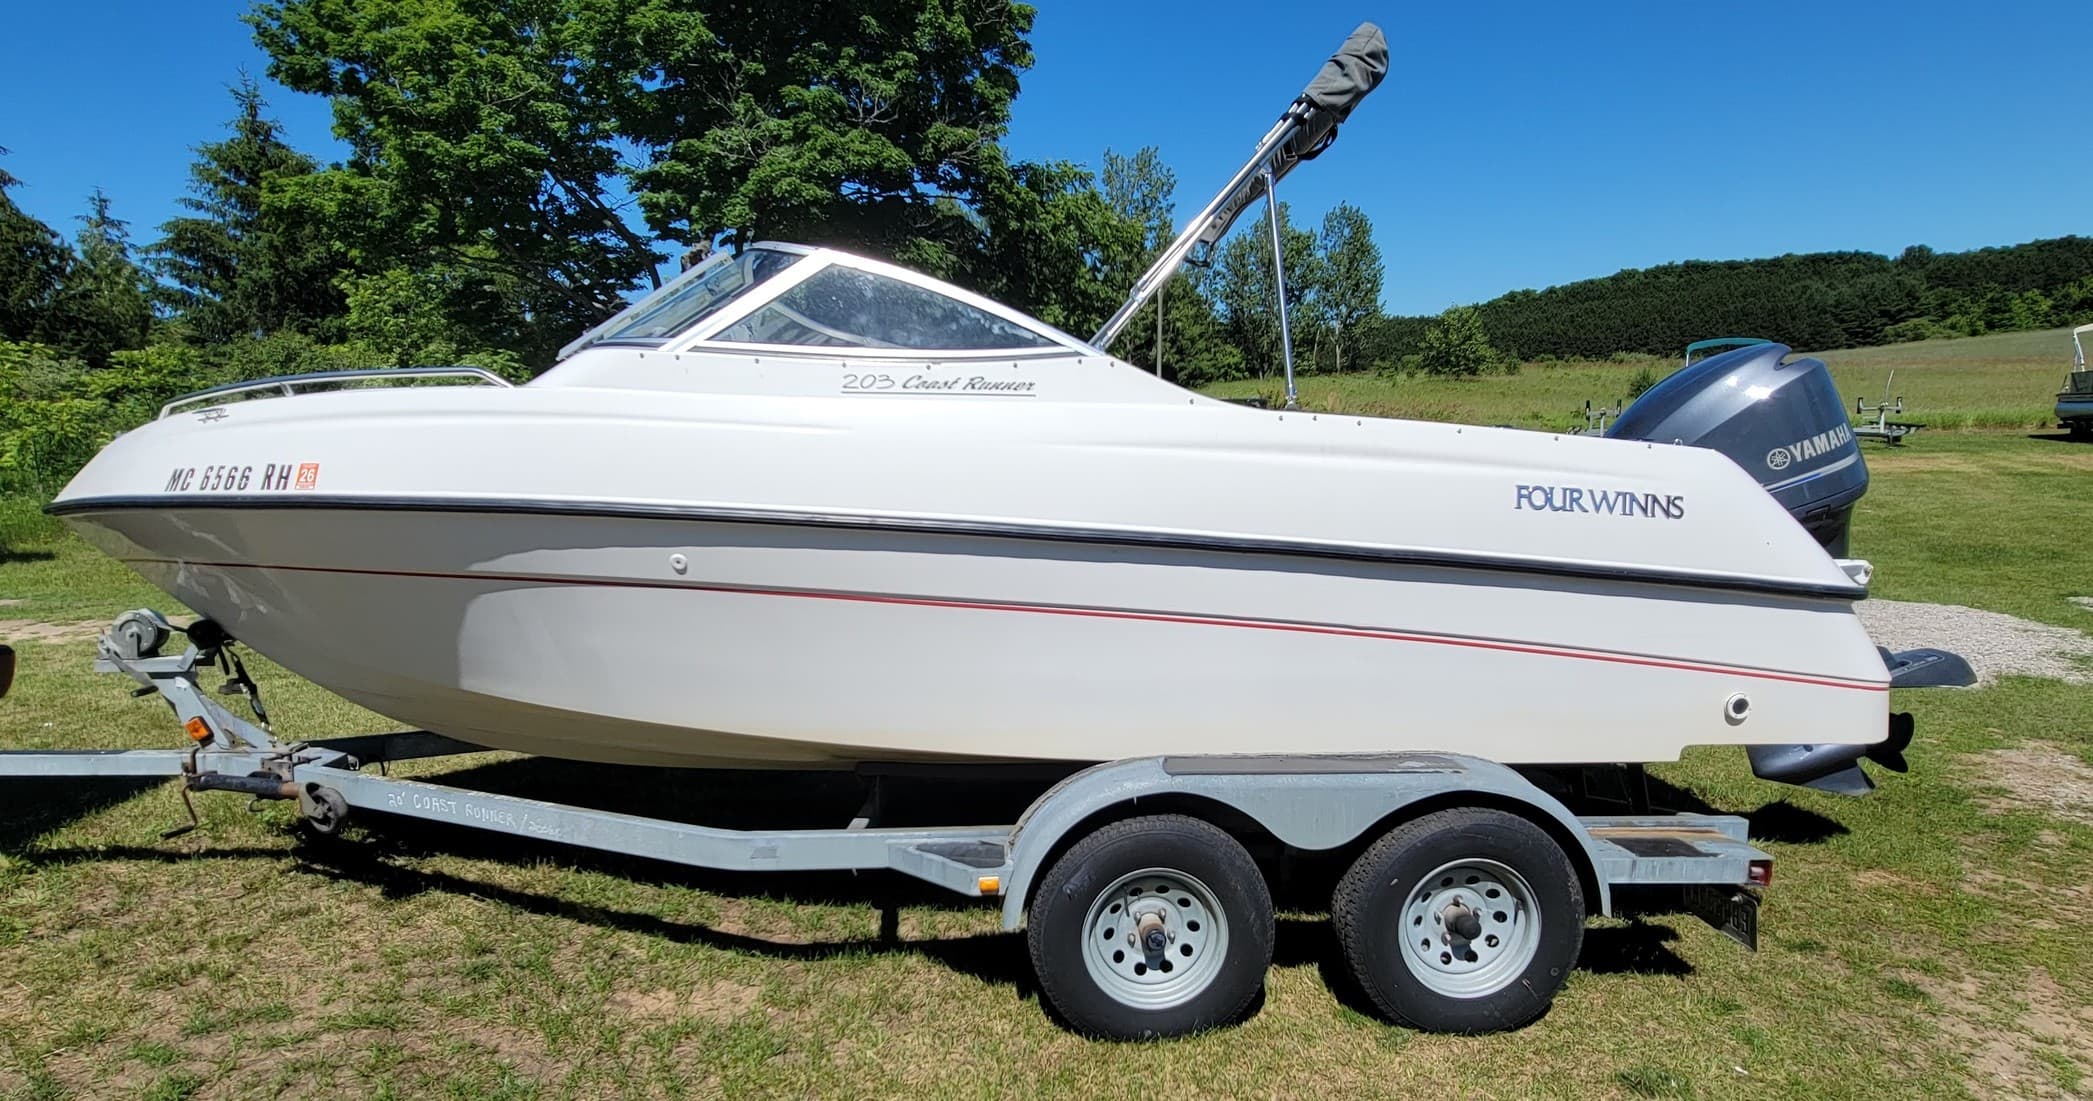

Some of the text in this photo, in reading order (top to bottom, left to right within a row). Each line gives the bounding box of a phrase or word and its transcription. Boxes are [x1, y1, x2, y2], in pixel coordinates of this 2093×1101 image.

[841, 374, 1036, 391] 203 Coast Runner
[1787, 422, 1853, 463] YAMAHA
[164, 463, 293, 492] MC 6566 RH
[298, 469, 315, 482] 26
[413, 793, 457, 815] COAST
